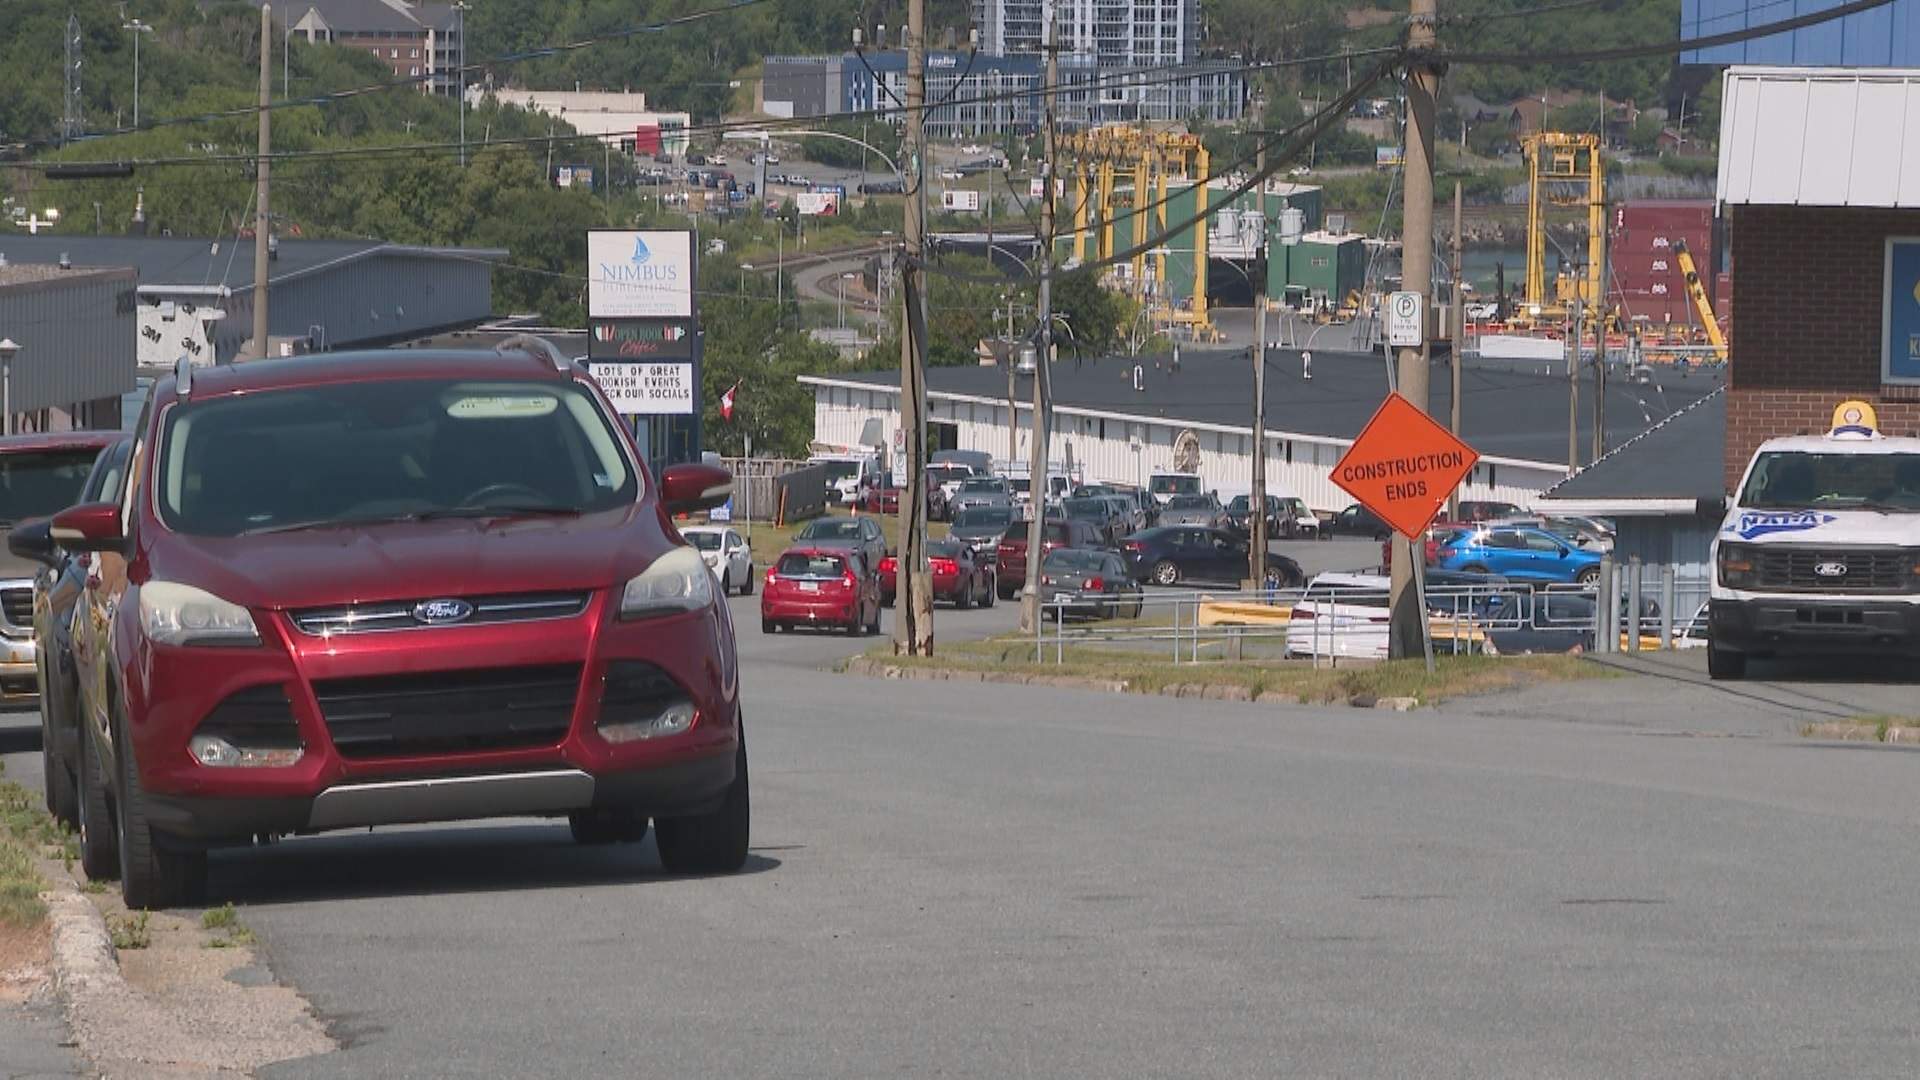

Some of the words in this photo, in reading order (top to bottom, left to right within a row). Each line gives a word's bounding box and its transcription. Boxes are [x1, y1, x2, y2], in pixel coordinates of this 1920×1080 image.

[600, 263, 677, 281] NIMBUS
[597, 366, 622, 376] LOTS
[630, 366, 643, 376] OF
[650, 366, 681, 376] GREAT
[644, 377, 681, 387] EVENTS
[624, 389, 644, 399] OUR
[649, 389, 690, 399] SOCIALS
[1343, 451, 1463, 483] CONSTRUCTION
[1386, 481, 1428, 501] ENDS
[425, 601, 460, 617] Ford
